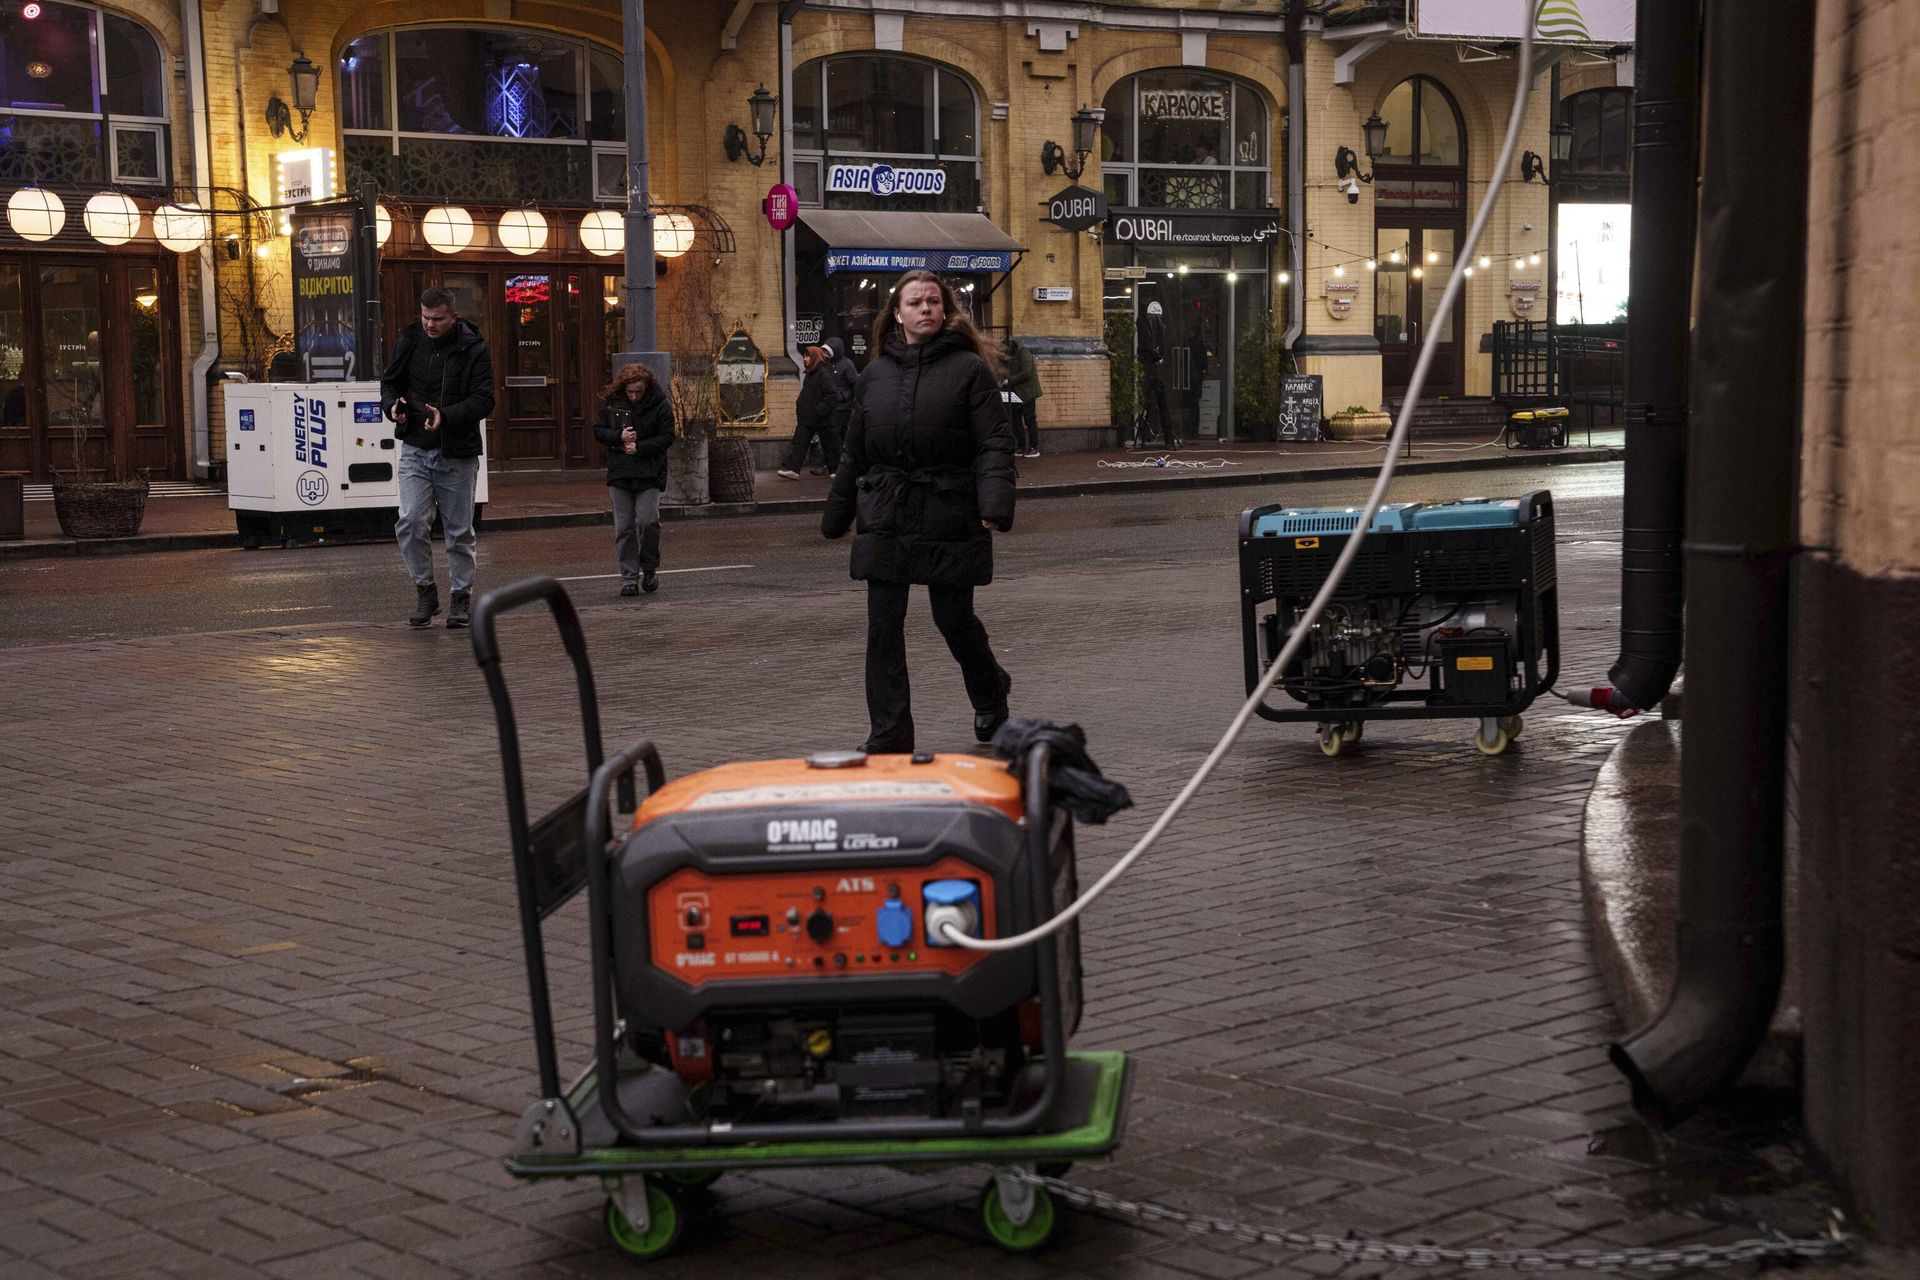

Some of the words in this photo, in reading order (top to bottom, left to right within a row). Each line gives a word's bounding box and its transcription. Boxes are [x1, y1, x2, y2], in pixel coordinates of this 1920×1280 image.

[1143, 94, 1222, 117] КАРАОКЕ
[833, 168, 870, 188] ASIA
[896, 172, 943, 191] FOODS
[771, 194, 787, 208] TIKI
[1051, 197, 1096, 220] DUBAI
[771, 209, 787, 220] THAI
[1116, 218, 1172, 241] DUBAI
[1173, 232, 1210, 242] restaurant
[1212, 232, 1240, 243] karaoke
[1242, 233, 1253, 243] bar
[314, 257, 341, 272] ДИНАМО
[851, 254, 889, 267] АЗІЙСЬКИХ
[891, 256, 926, 268] ПРОДУКТІВ
[949, 256, 968, 268] ASIA
[978, 257, 1000, 268] FOODS
[300, 275, 354, 299] ВІДКРИТО!
[59, 343, 87, 351] ЗУСТРІЧ
[294, 392, 307, 463] ENERGY
[309, 398, 328, 468] PLUS
[837, 877, 874, 892] ATS
